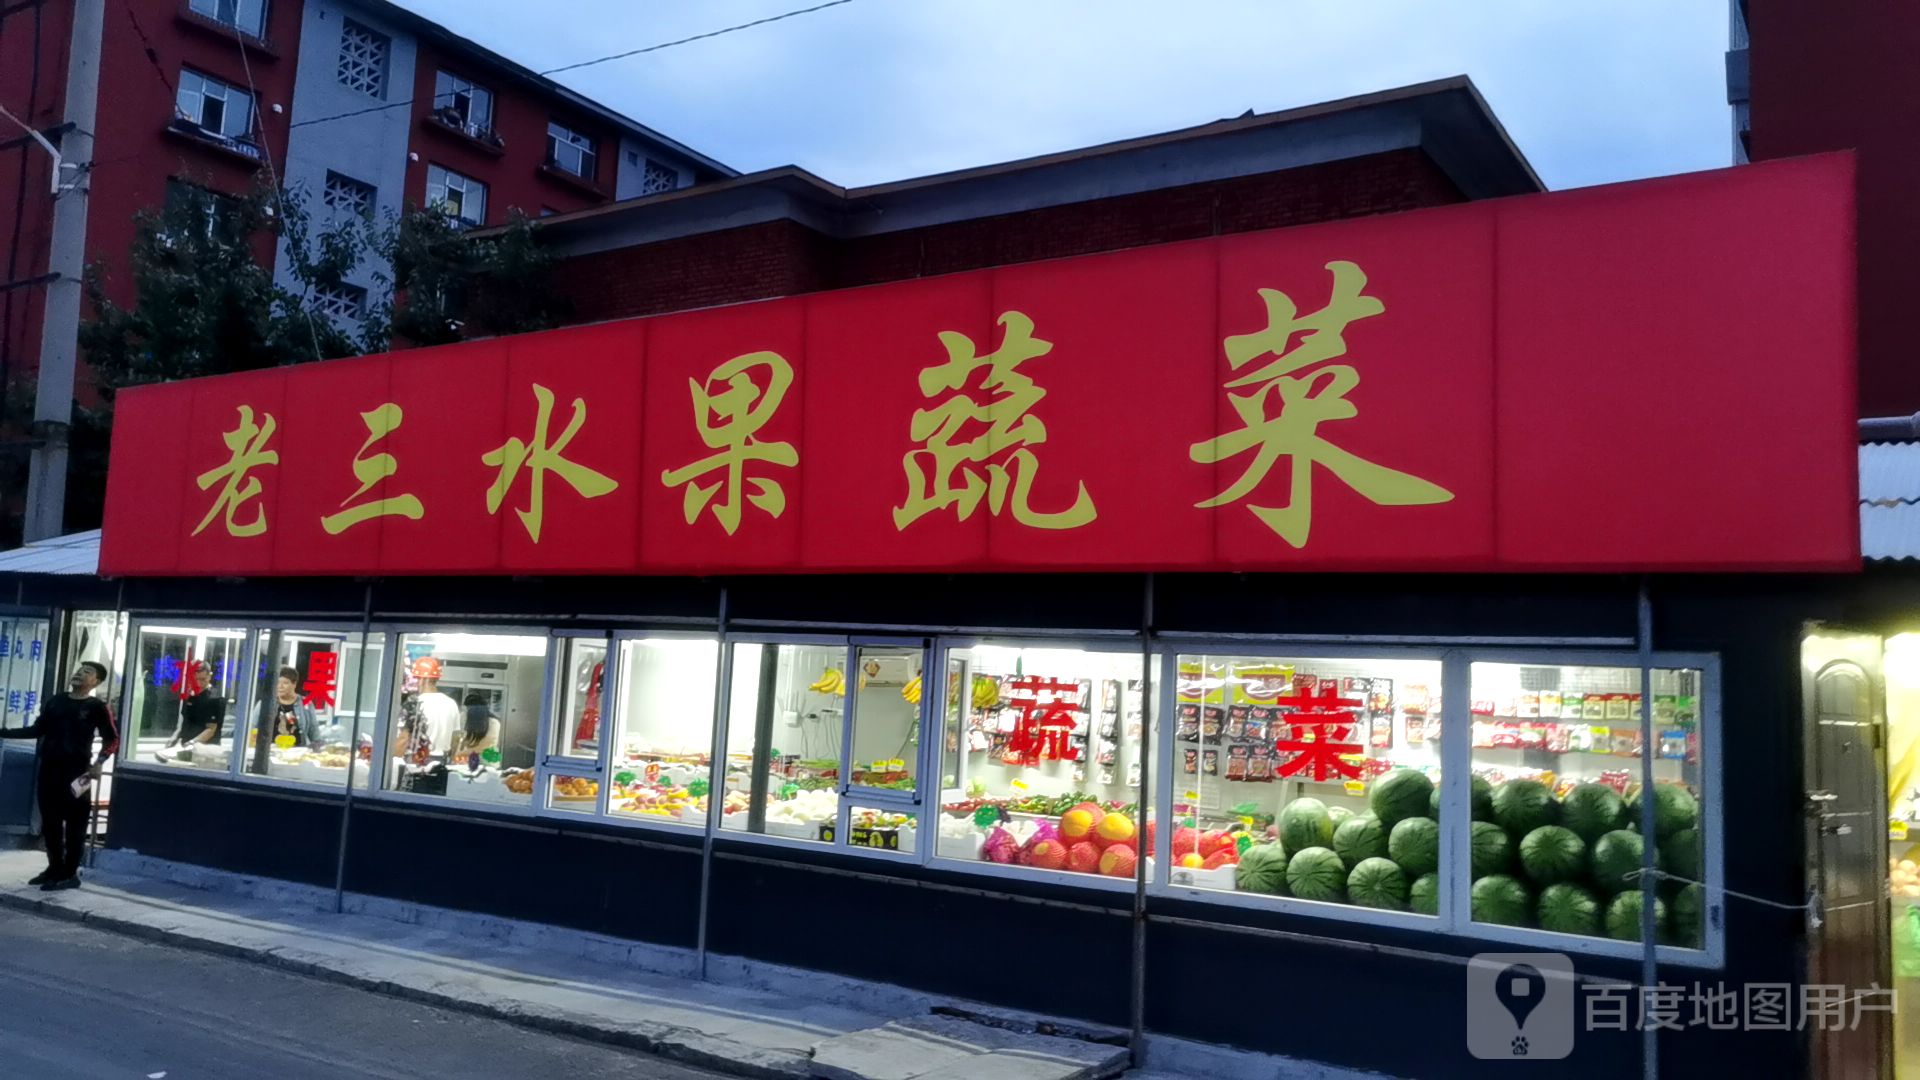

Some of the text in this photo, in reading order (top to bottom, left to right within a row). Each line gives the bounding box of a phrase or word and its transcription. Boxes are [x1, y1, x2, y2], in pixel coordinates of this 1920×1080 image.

[191, 260, 1455, 548] 老三水果蔬菜
[303, 651, 338, 711] 果
[1010, 676, 1080, 762] 蔬
[1276, 686, 1364, 782] 菜
